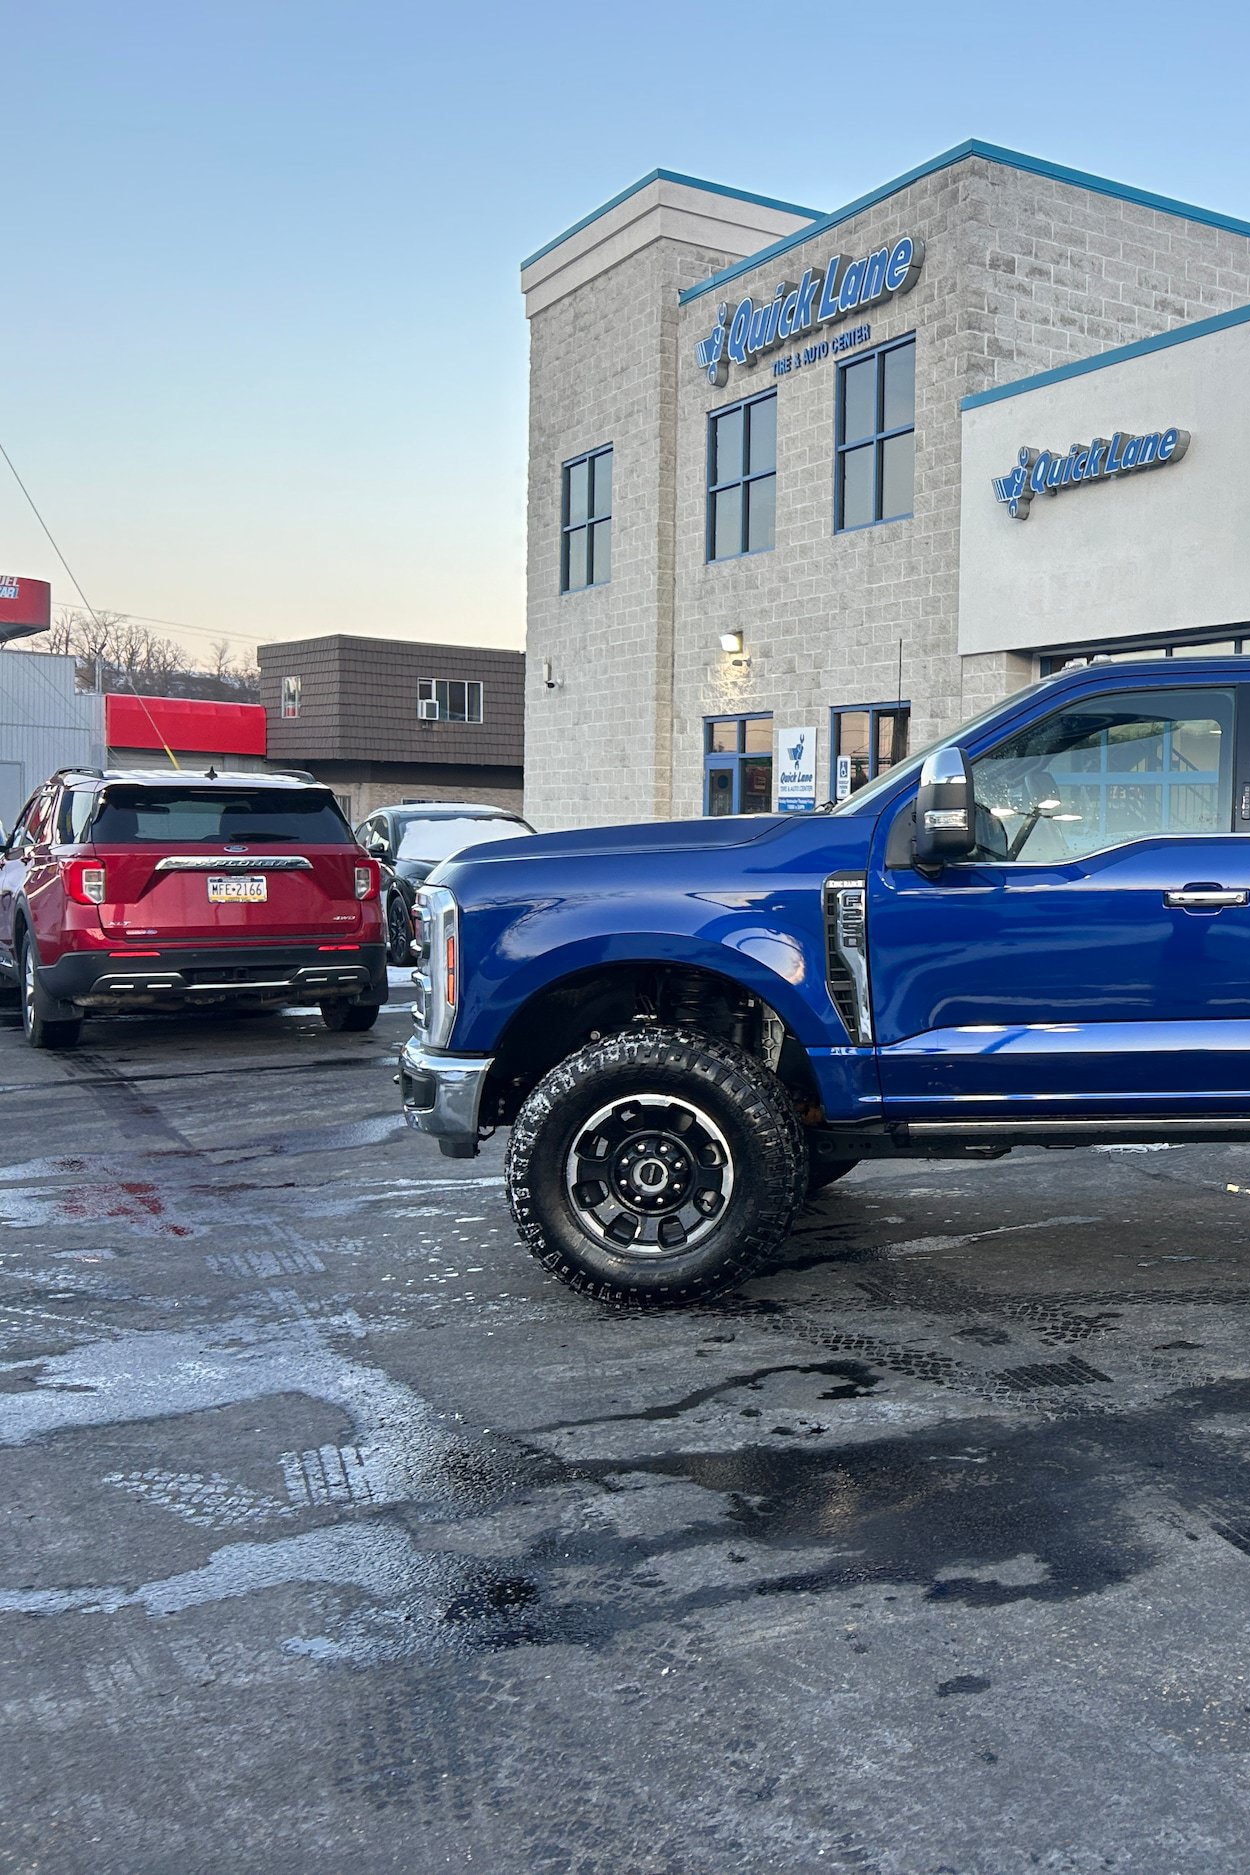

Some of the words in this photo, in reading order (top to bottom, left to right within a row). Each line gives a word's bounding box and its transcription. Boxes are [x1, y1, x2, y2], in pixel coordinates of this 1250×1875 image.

[728, 267, 821, 365] Quick
[816, 236, 916, 324] Lane
[773, 355, 792, 378] TIRE
[794, 352, 801, 369] &
[803, 341, 829, 366] AUTO
[832, 323, 871, 354] CENTER
[1029, 438, 1107, 495] Quick
[1103, 427, 1182, 475] Lane
[780, 771, 797, 785] Quick
[797, 771, 814, 784] Lane
